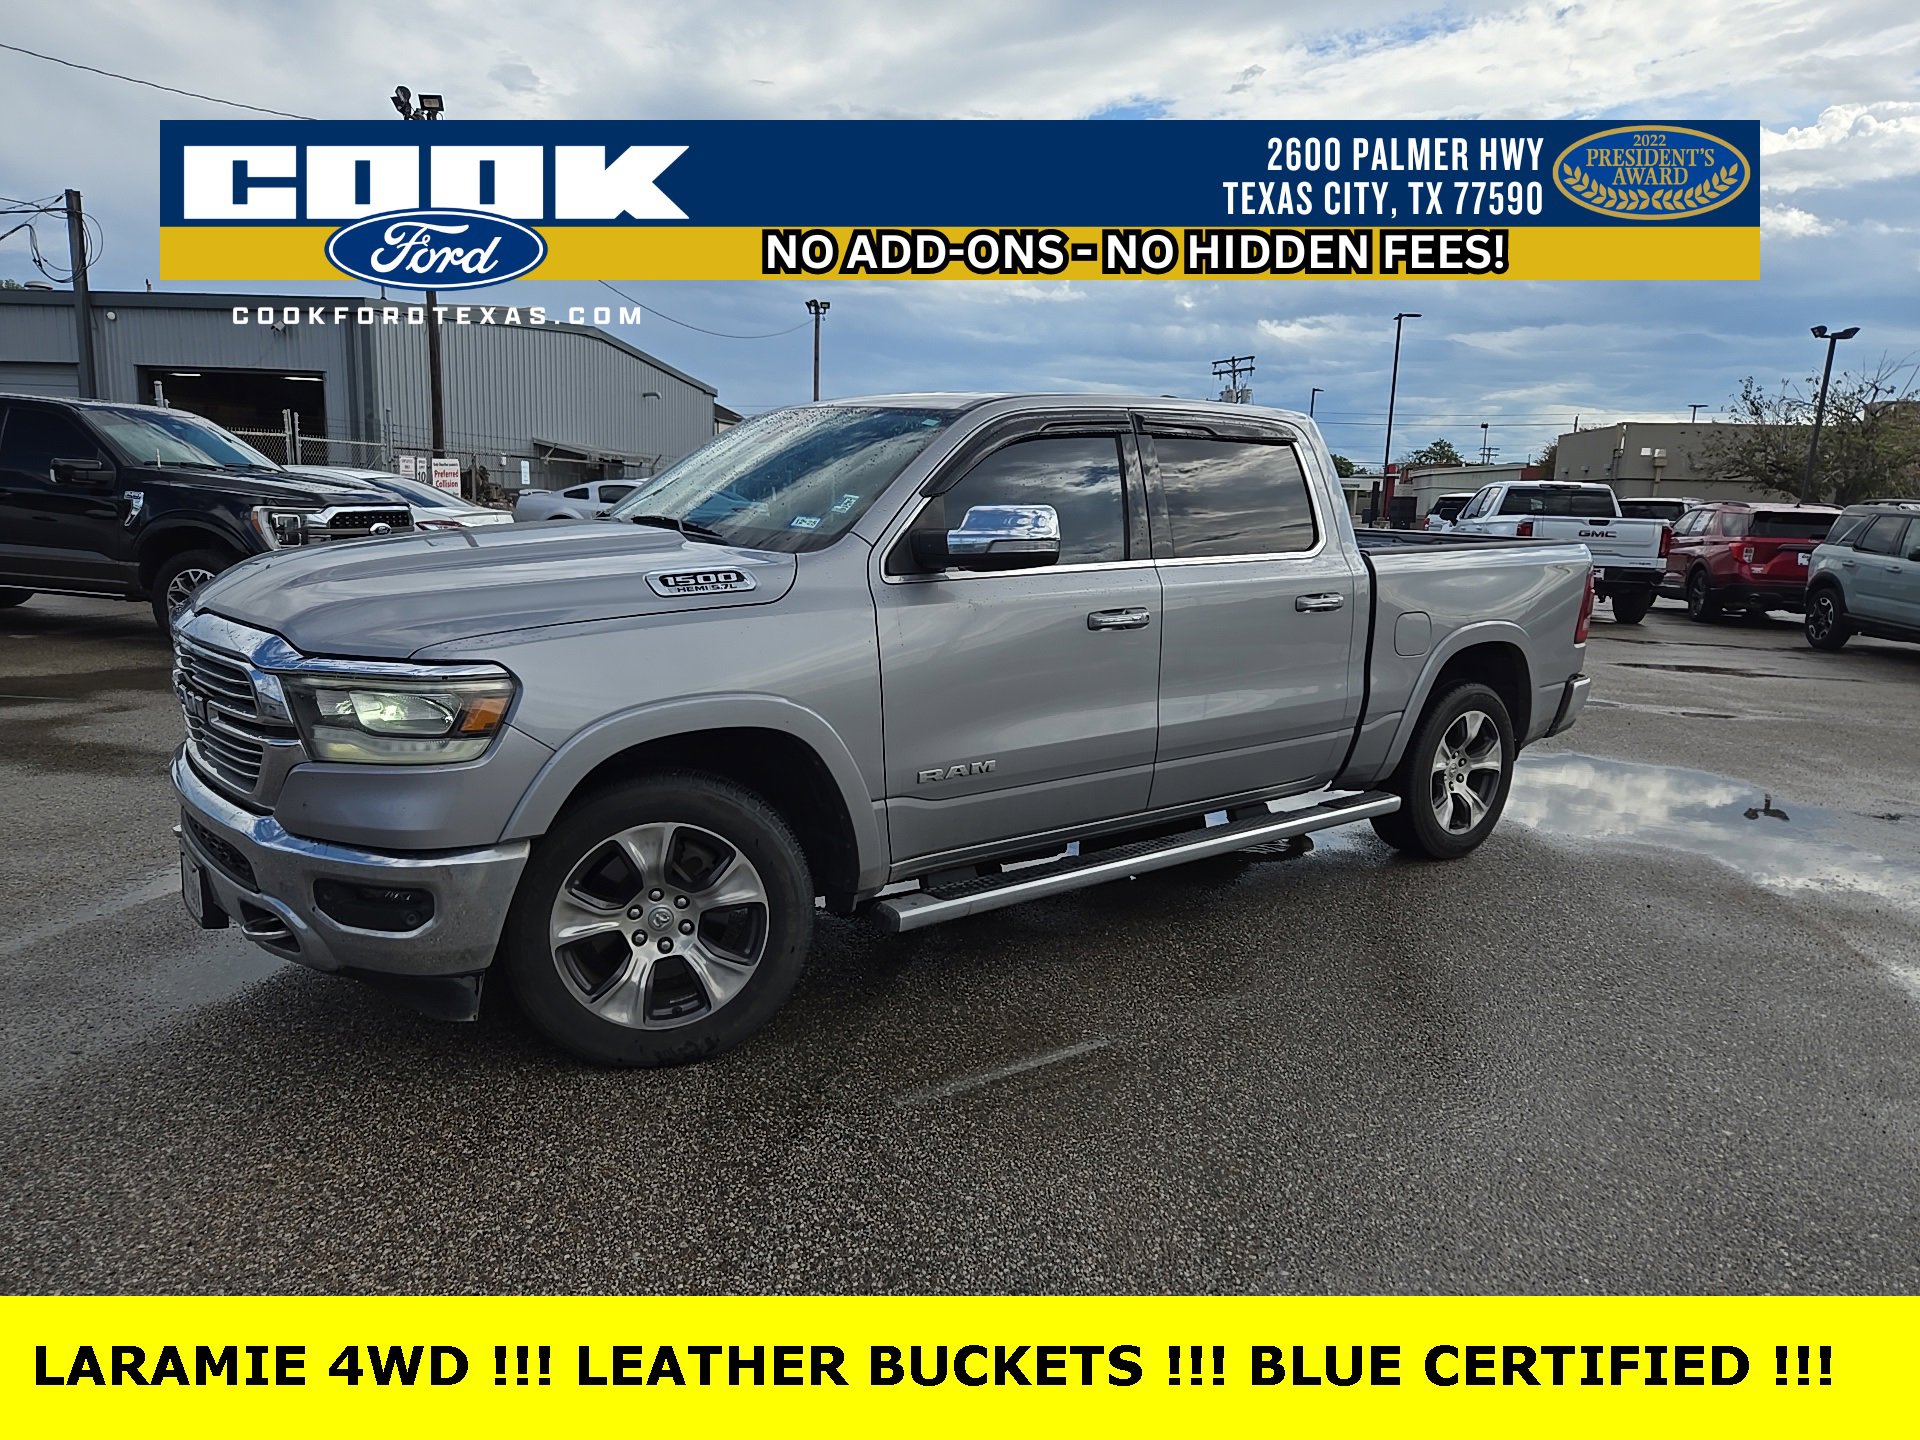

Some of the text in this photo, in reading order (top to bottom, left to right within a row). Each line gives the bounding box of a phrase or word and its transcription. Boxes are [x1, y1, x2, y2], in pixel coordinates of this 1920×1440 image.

[417, 471, 427, 483] 10
[434, 469, 459, 478] Preferred
[435, 480, 459, 488] Collision
[1578, 530, 1617, 538] GMC
[663, 572, 738, 586] 1500
[677, 583, 738, 593] HEMI 5.7L
[917, 759, 996, 784] RAM
